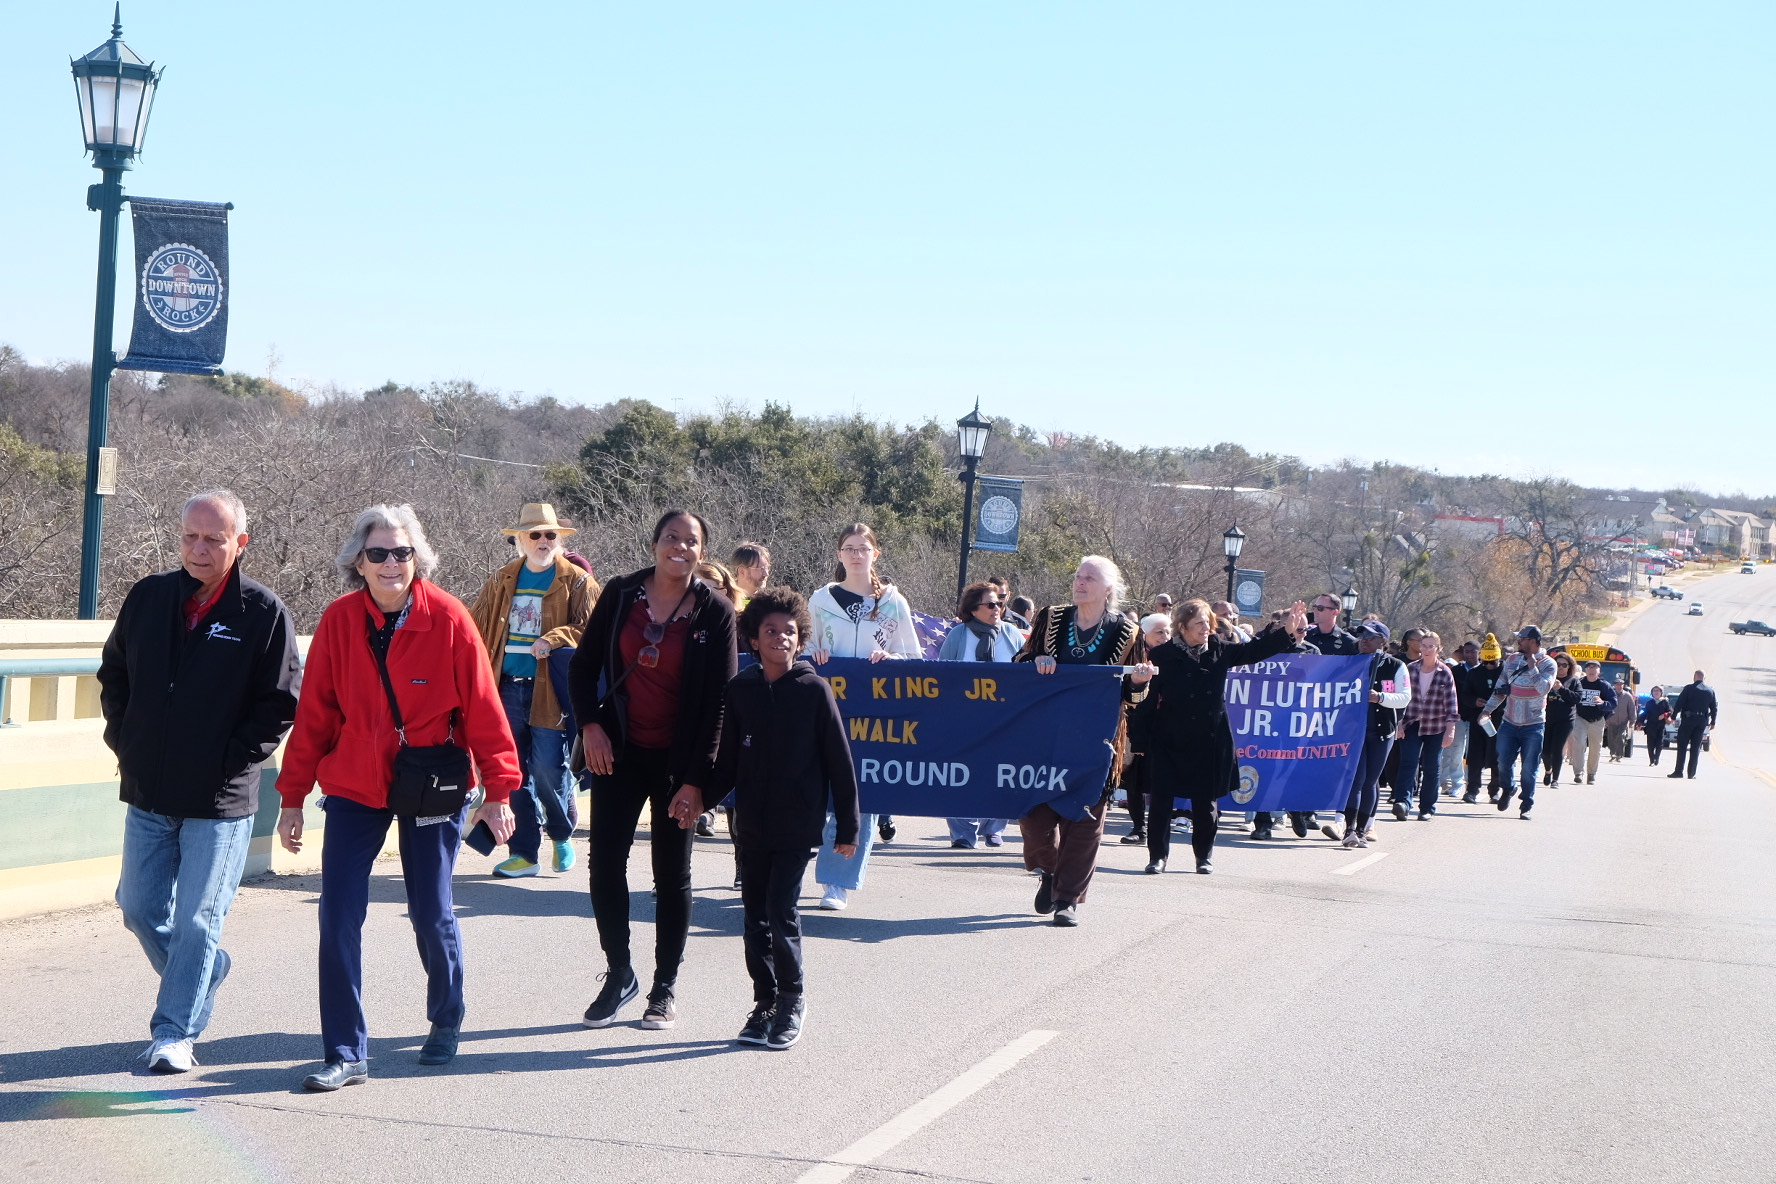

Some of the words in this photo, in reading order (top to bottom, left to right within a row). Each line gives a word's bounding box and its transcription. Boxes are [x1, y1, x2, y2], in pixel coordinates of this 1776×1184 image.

[157, 253, 206, 275] ROUND
[148, 279, 216, 297] DOWNTOWN
[162, 306, 199, 321] ROCK
[1570, 649, 1591, 658] SCHOOL
[1592, 650, 1604, 658] BUS
[823, 676, 847, 700] R
[871, 676, 940, 700] KING
[964, 677, 1006, 702] JR.
[1260, 677, 1362, 709] LUTHER
[849, 717, 919, 745] WALK
[1236, 709, 1279, 737] JR.
[1288, 708, 1340, 738] DAY
[1235, 742, 1352, 760] eCommUNITY
[860, 758, 970, 787] ROUND
[996, 763, 1069, 792] ROCK
